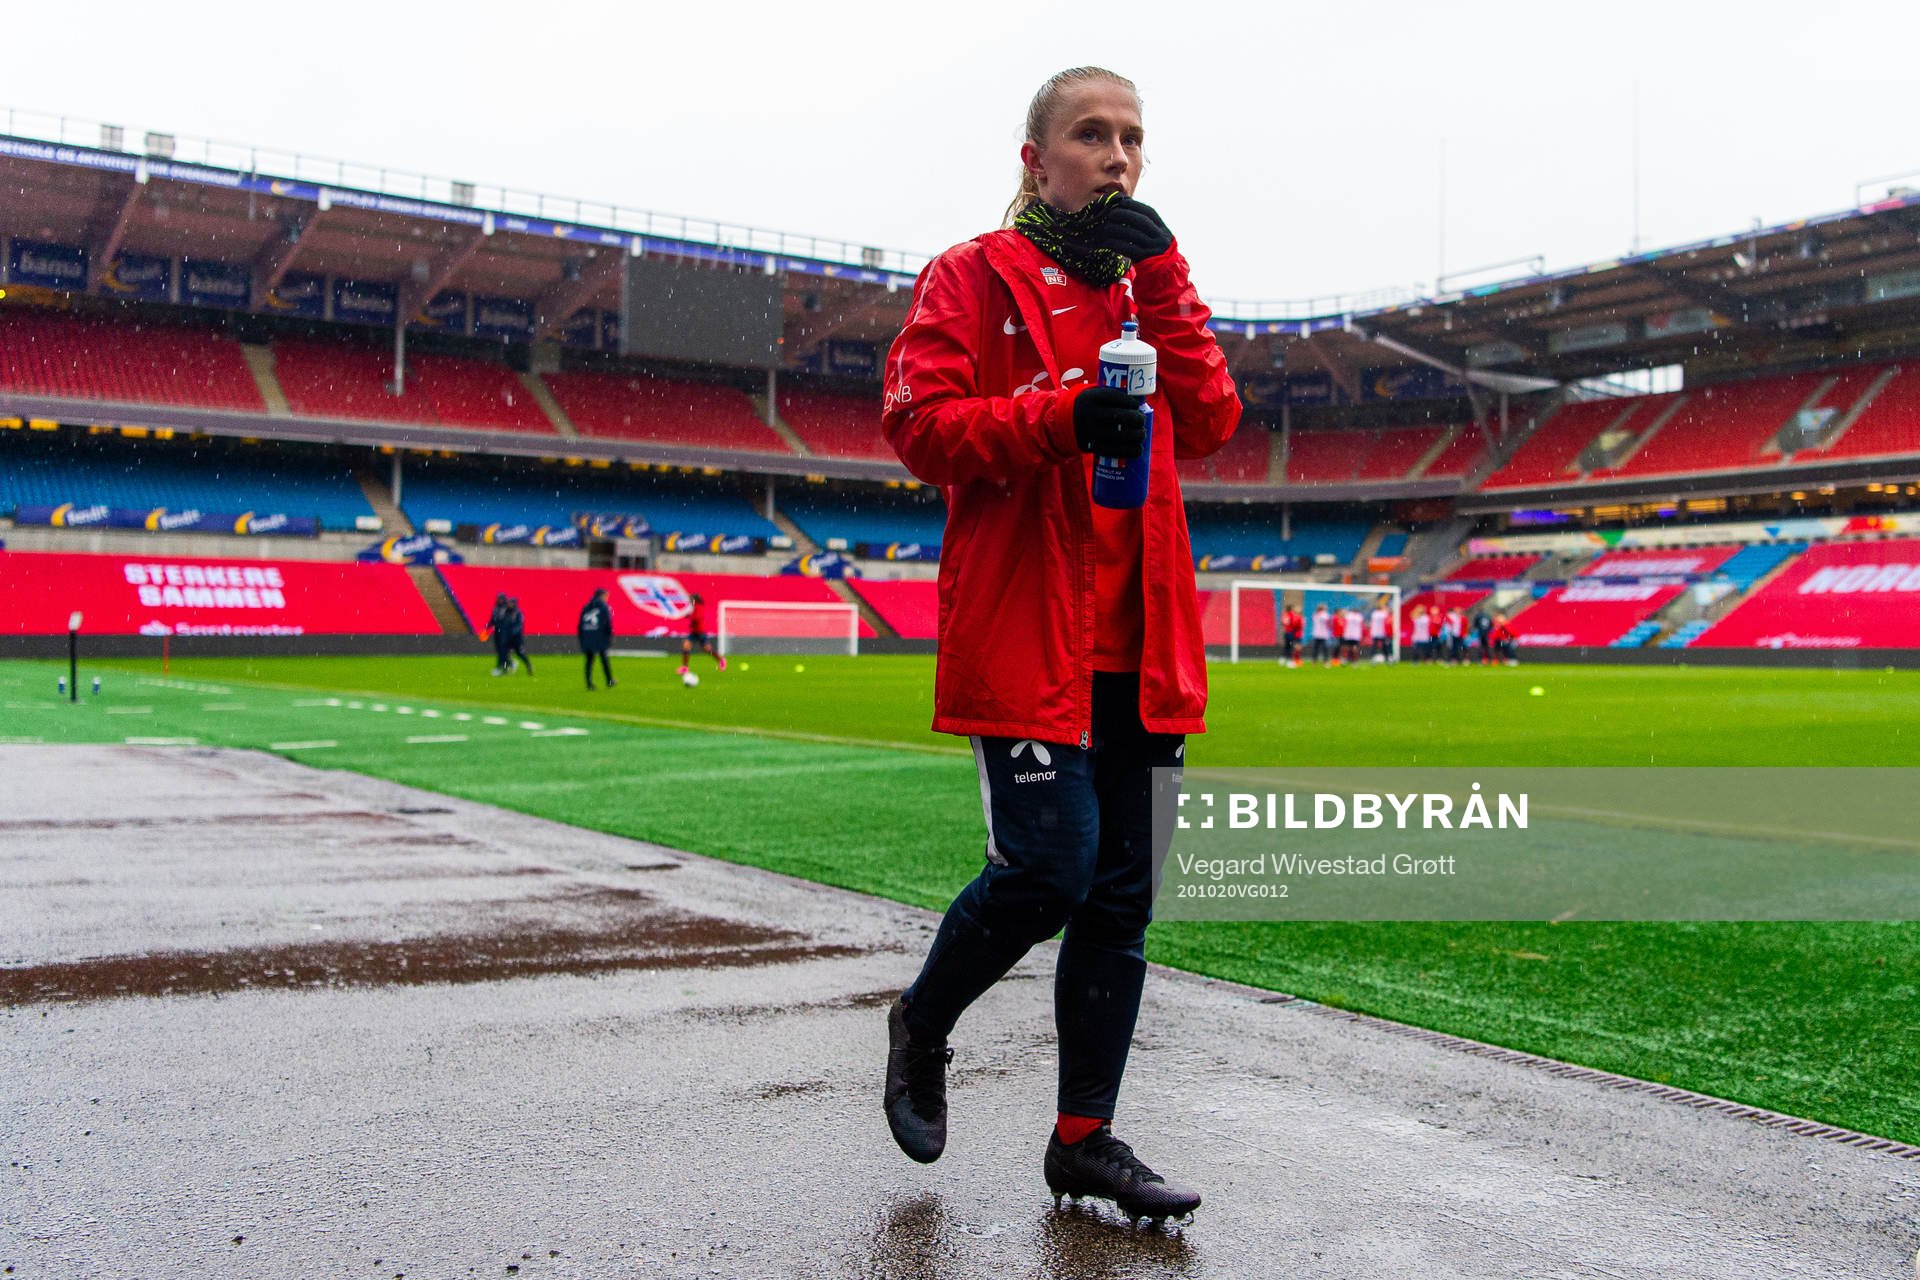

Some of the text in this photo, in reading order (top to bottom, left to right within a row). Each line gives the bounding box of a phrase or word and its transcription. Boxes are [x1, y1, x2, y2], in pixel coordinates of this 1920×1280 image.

[124, 563, 285, 588] STERKERE
[138, 584, 286, 609] SAMMEN
[1014, 769, 1057, 784] telenor
